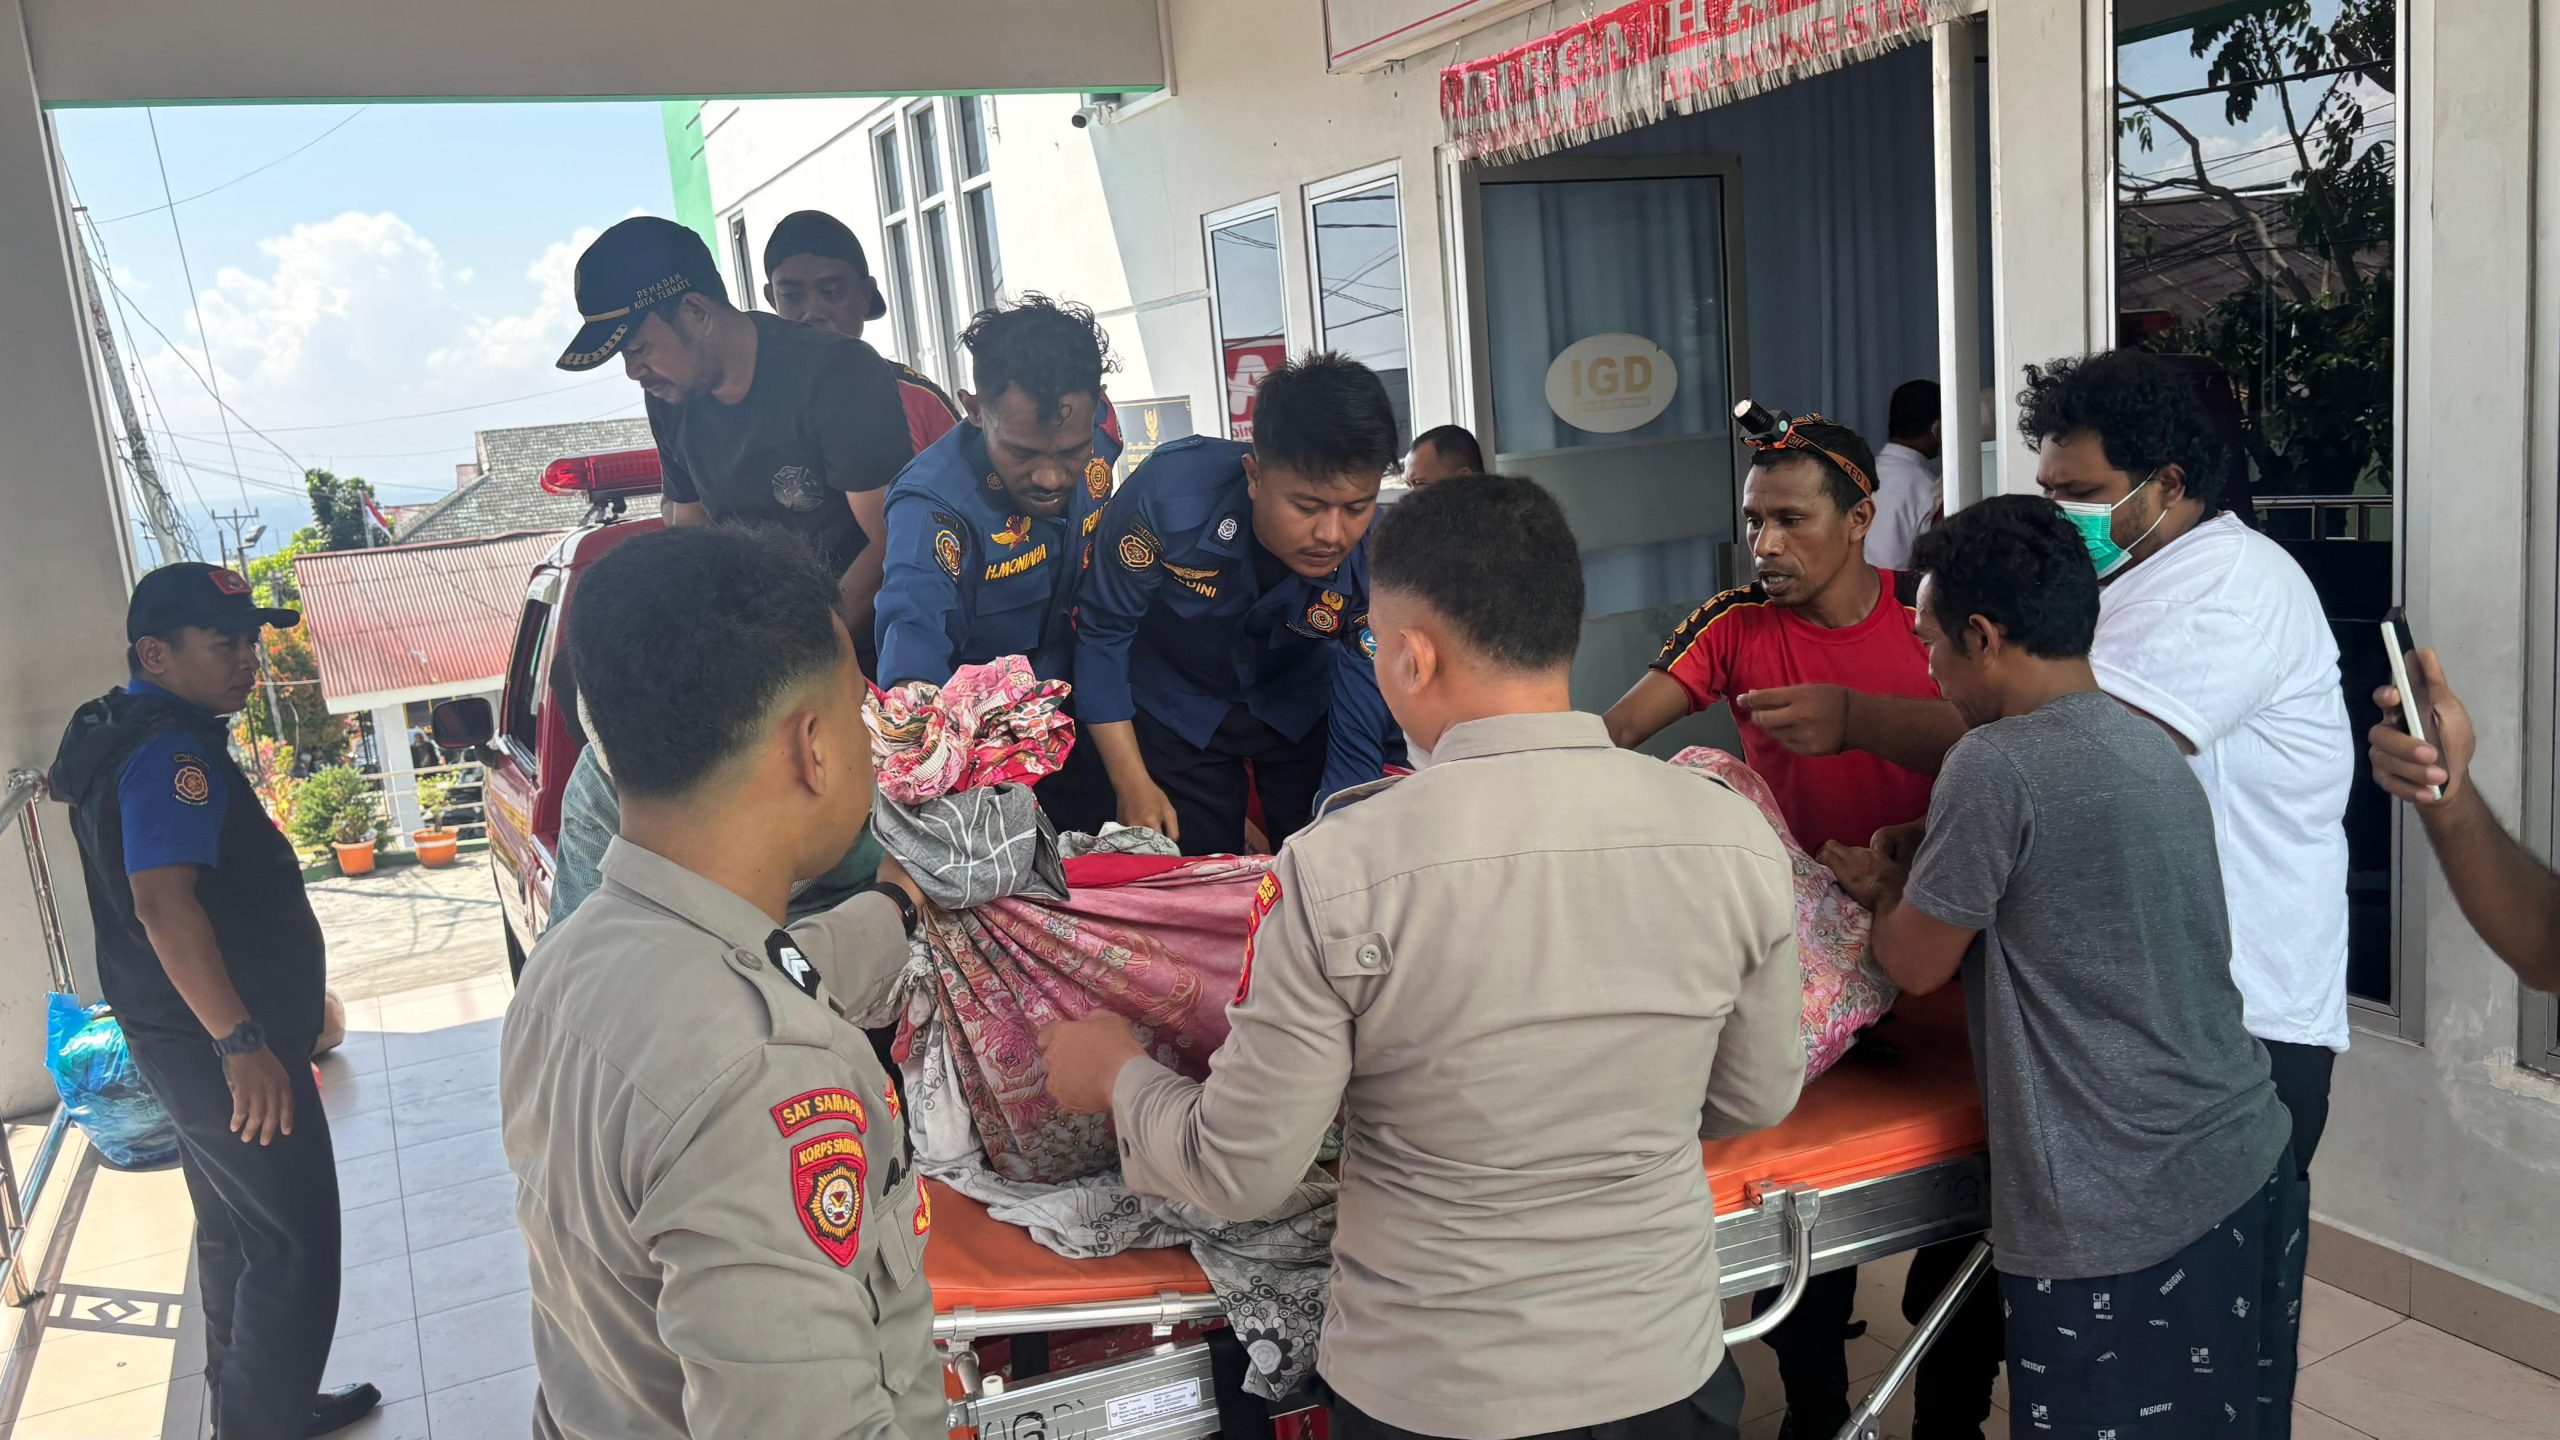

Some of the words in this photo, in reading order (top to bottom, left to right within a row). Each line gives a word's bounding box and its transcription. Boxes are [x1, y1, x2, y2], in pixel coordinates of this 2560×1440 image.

[634, 297, 655, 310] KOTA
[656, 278, 691, 300] TERNATE
[636, 273, 682, 299] PEMADAM
[1571, 355, 1653, 398] IGD
[783, 1100, 811, 1125] SAT
[799, 1140, 833, 1166] KORPS
[2159, 1268, 2186, 1296] INSIGHT
[2139, 1402, 2173, 1417] INSIGHT
